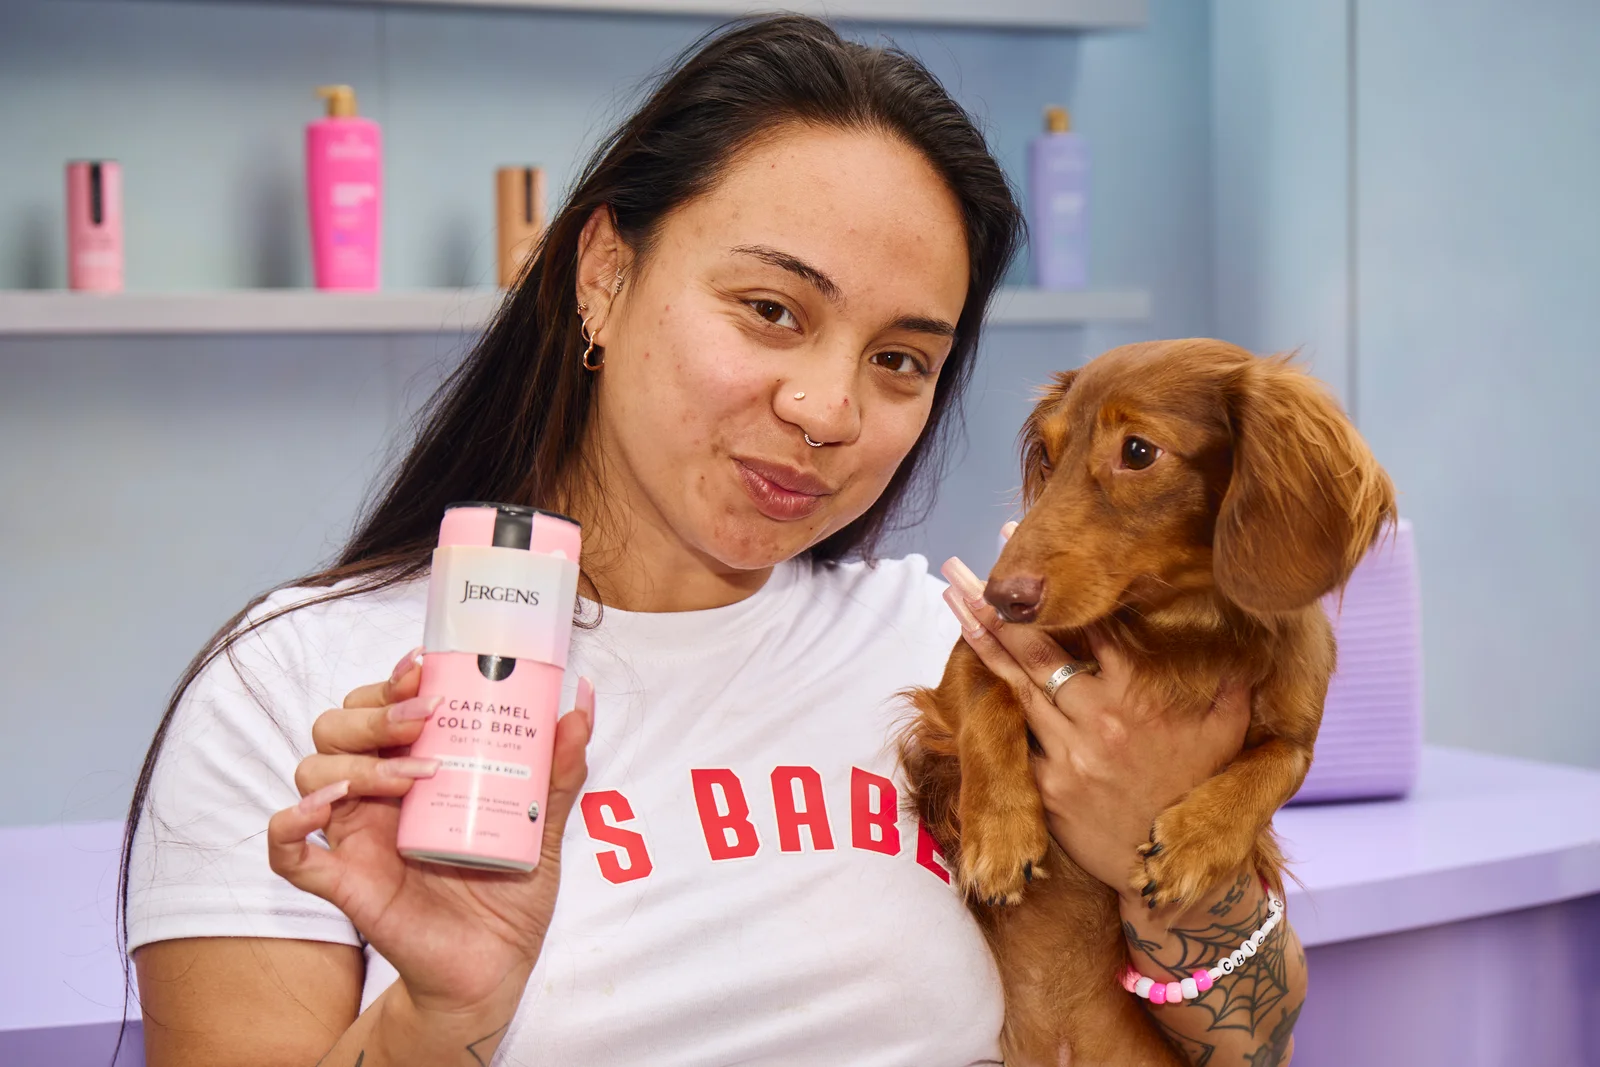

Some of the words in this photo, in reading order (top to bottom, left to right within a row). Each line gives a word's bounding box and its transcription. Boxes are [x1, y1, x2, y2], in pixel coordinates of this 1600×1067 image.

[459, 580, 540, 606] JERGENS
[449, 699, 531, 720] CARAMEL
[437, 716, 482, 731] COLD
[490, 720, 538, 739] BREW
